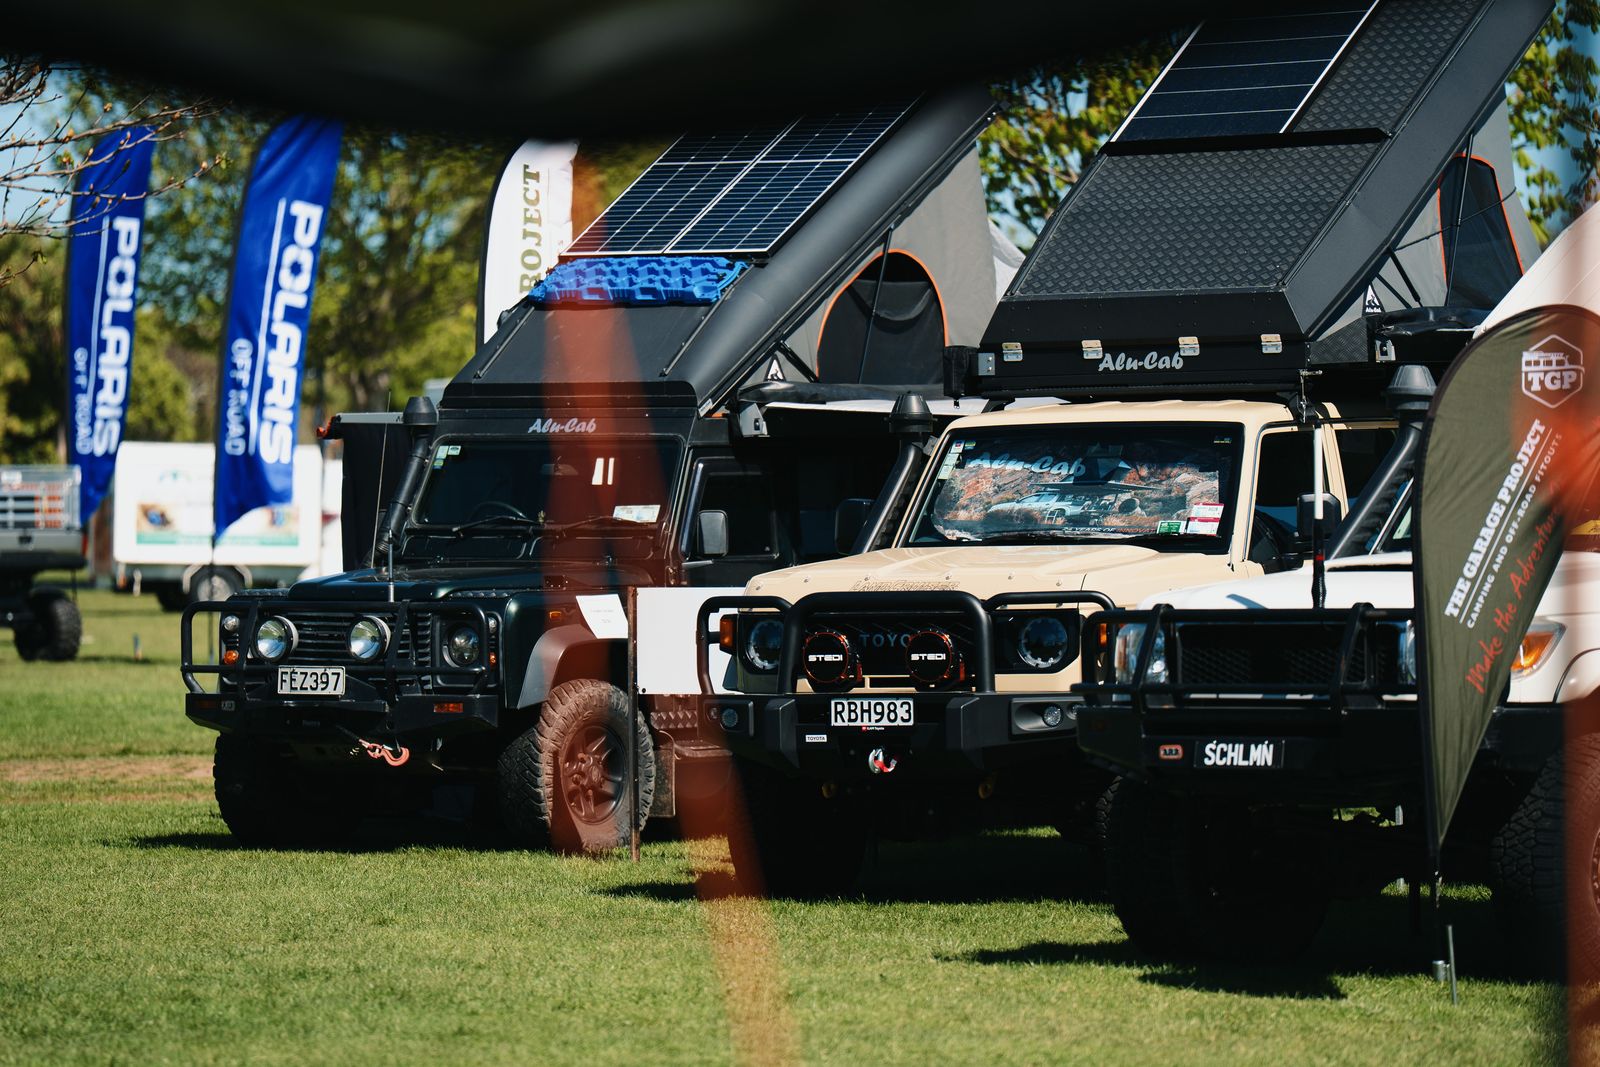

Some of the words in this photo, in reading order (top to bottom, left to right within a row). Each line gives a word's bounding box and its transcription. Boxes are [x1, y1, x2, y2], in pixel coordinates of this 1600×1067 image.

[520, 164, 542, 293] ROJECT
[94, 216, 140, 457] POLARIS
[260, 200, 323, 465] POLARIS
[74, 347, 88, 390] OFF
[229, 338, 253, 388] OFF
[1098, 351, 1184, 372] Alu-Cab
[1527, 370, 1577, 391] TGP
[75, 393, 94, 455] ROAD
[225, 389, 249, 456] ROAD
[528, 417, 597, 434] Alu-Cab
[966, 452, 1086, 477] Alu-Cab
[1444, 577, 1472, 618] THE
[1463, 501, 1507, 578] GARAGE
[1497, 419, 1545, 504] PROJECT
[1467, 573, 1496, 629] CAMPING
[1492, 545, 1508, 573] AND
[1505, 484, 1537, 544] OFF-ROAD
[1535, 432, 1563, 482] FITOUTS
[808, 654, 843, 662] STEDI
[859, 633, 911, 648] TOYO
[911, 653, 947, 661] STEDI
[1465, 636, 1503, 694] Make
[1493, 602, 1518, 634] the
[279, 671, 342, 692] FEZ397
[834, 701, 912, 723] RBH983
